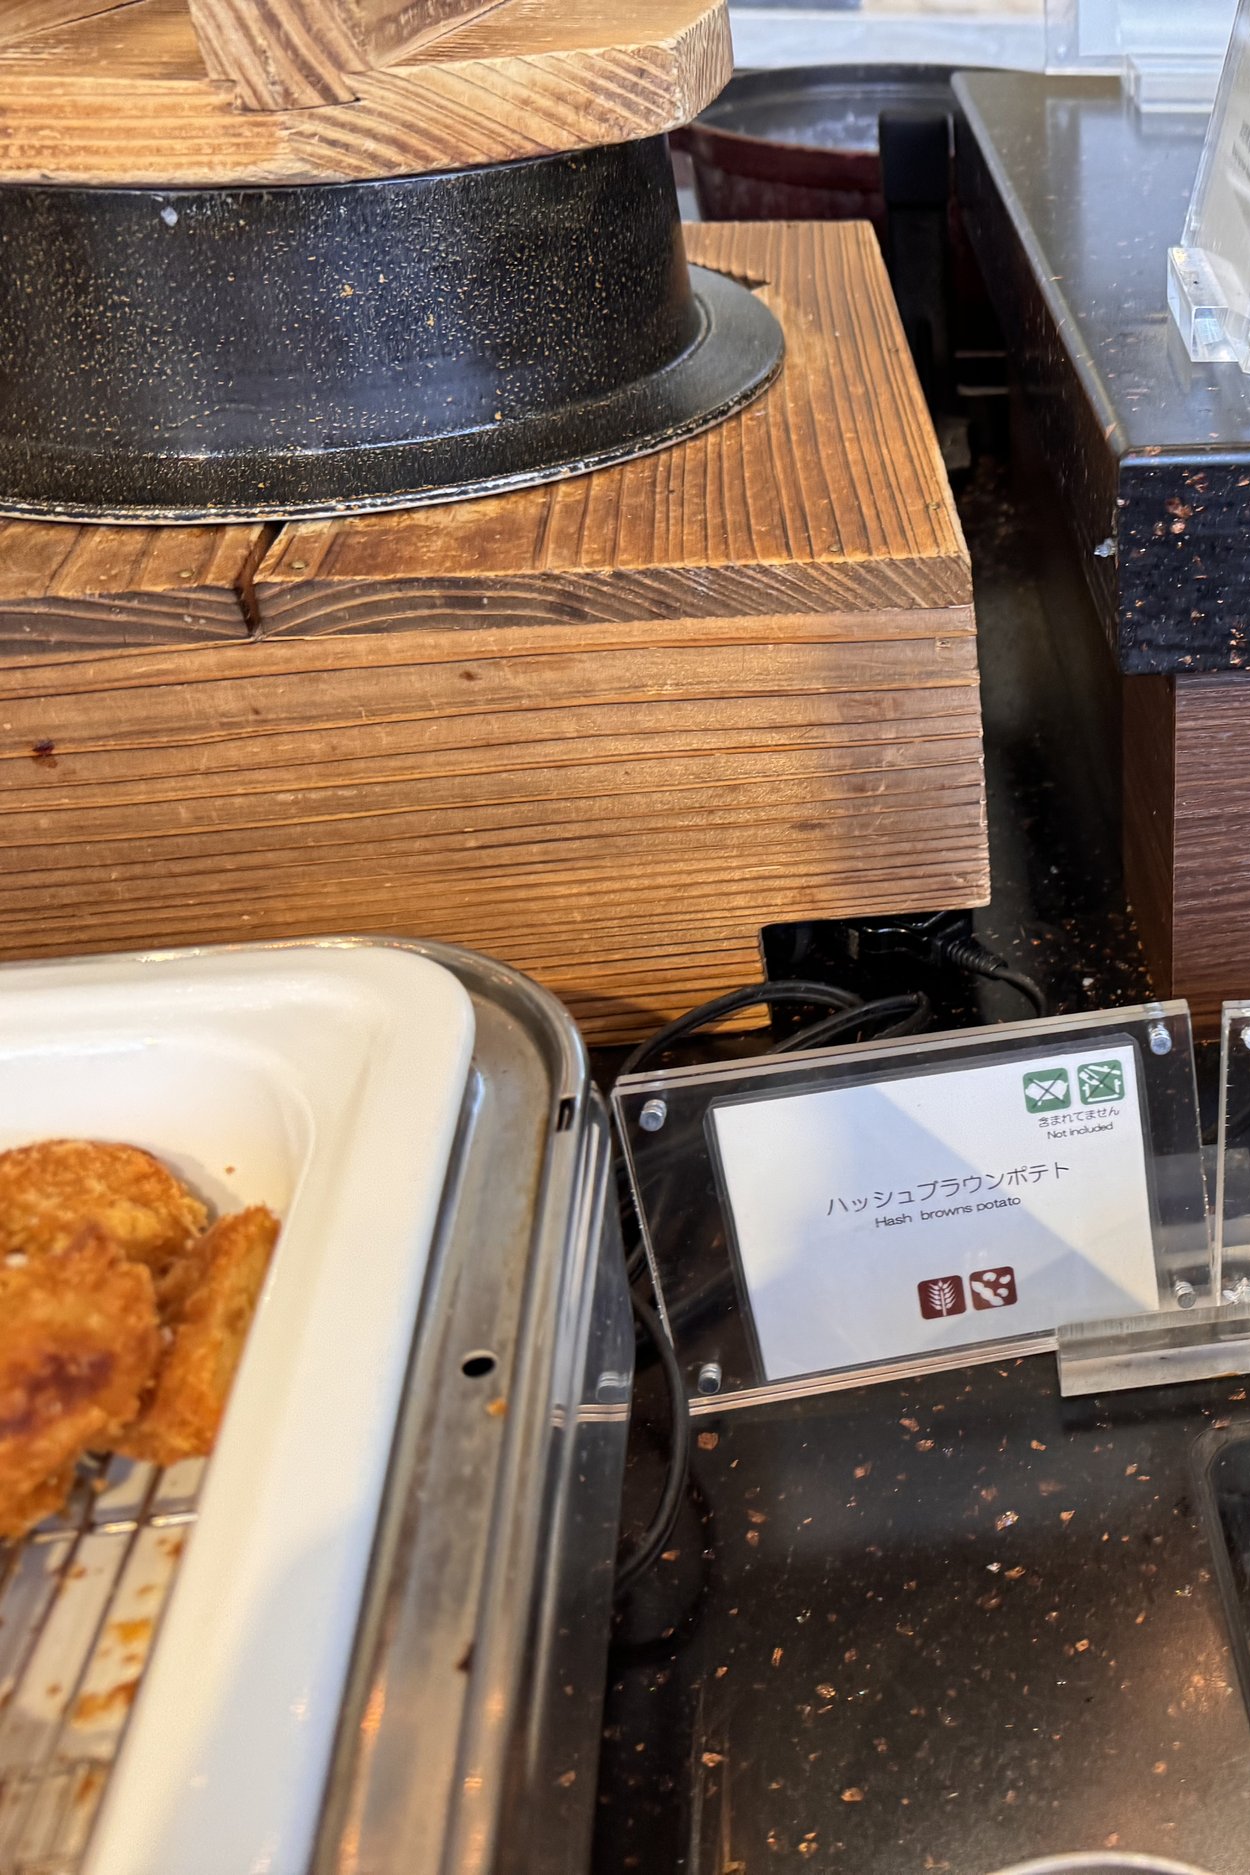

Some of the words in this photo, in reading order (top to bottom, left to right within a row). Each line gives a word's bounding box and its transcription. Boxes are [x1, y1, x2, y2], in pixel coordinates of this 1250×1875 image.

[1038, 1107, 1119, 1128] 含まれてません
[1047, 1130, 1068, 1139] Not
[1069, 1122, 1114, 1136] included
[827, 1161, 1070, 1216] ハッシュブラウンポテト
[875, 1213, 913, 1228] Hash
[920, 1205, 973, 1221] browns
[976, 1195, 1021, 1212] potato
